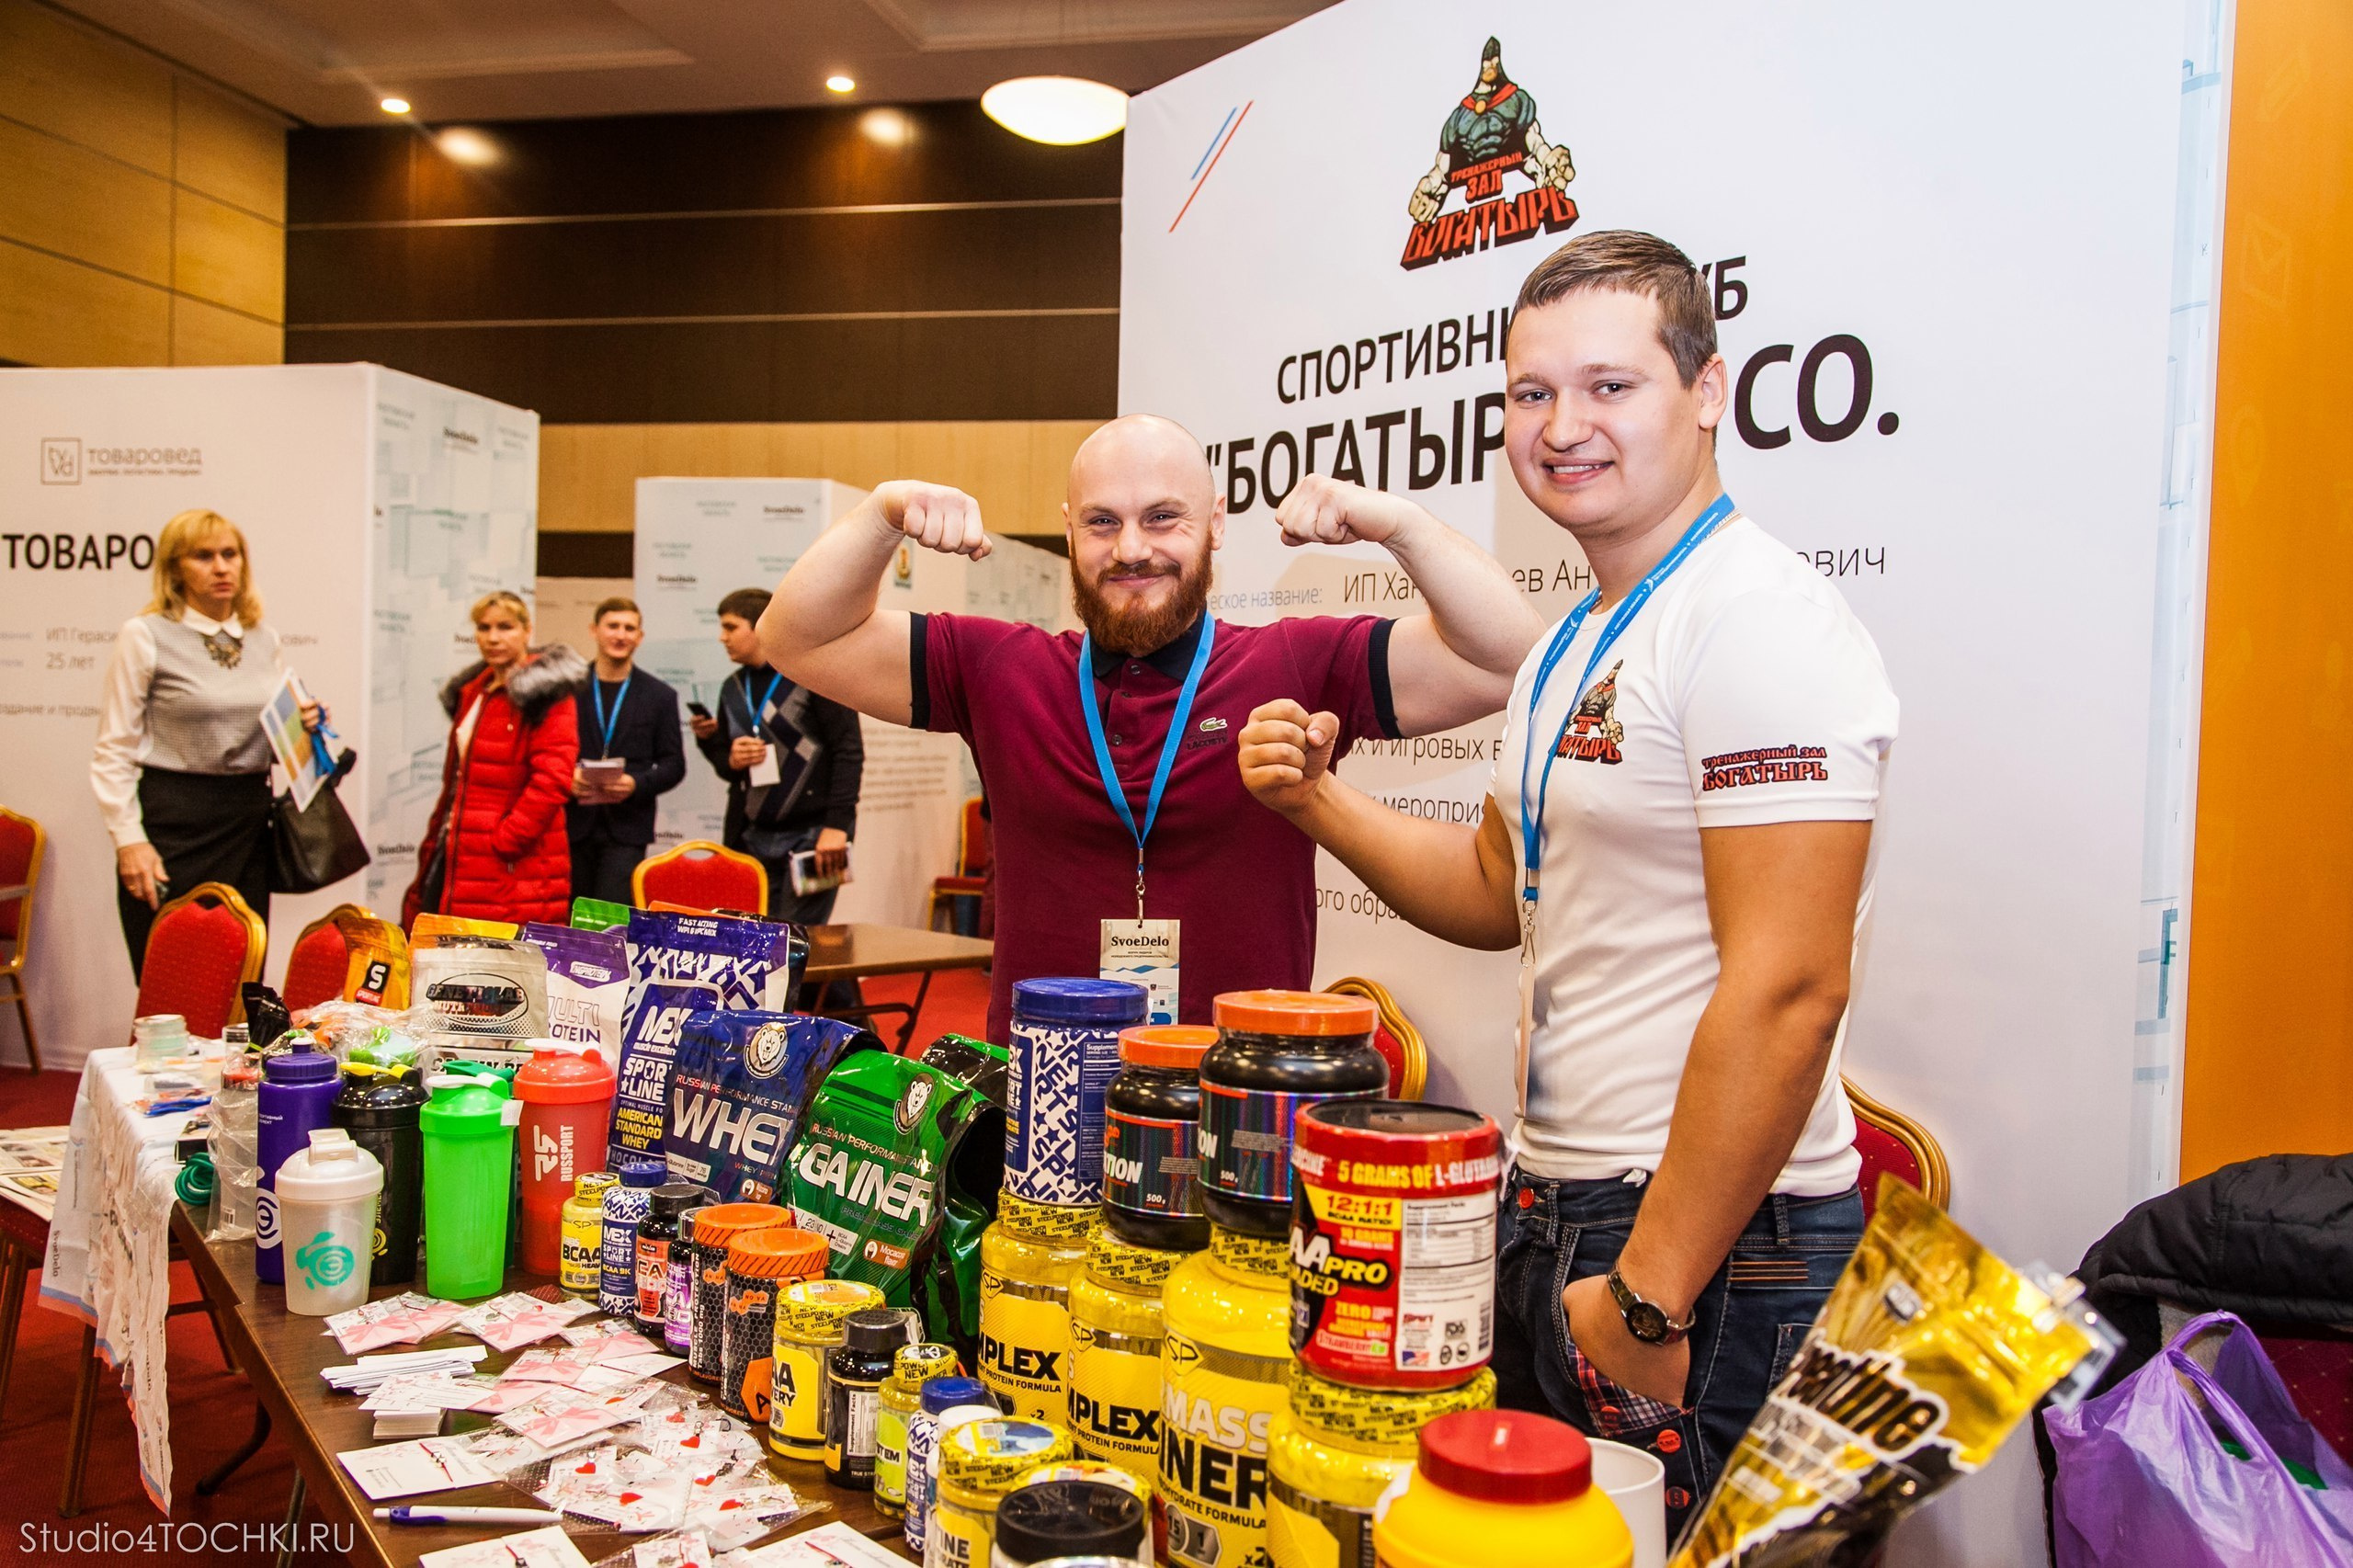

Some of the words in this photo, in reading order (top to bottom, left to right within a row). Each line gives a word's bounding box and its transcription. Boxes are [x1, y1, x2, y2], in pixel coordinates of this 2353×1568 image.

[1467, 169, 1503, 200] ЗАЛ
[1401, 186, 1578, 270] БОГАТЫРЬ
[1207, 591, 1247, 611] еское
[1251, 586, 1324, 608] название:
[1344, 573, 1376, 603] ИП
[46, 652, 73, 670] 25
[1702, 761, 1829, 791] БОГАТЫРЬ
[1351, 890, 1403, 925] обра
[1110, 936, 1170, 948] SvoeDelo
[637, 1006, 693, 1047] MEX
[623, 1057, 673, 1083] SPOR
[676, 1074, 710, 1091] RUSSIAN
[628, 1078, 665, 1102] LINE
[615, 1119, 663, 1141] STANDARD
[617, 1107, 663, 1128] AMERICAN
[560, 1124, 574, 1182] RUSSPORT
[621, 1133, 650, 1150] WHEY
[847, 1133, 896, 1161] PERFORMA
[798, 1142, 935, 1228] GAINER
[1337, 1159, 1350, 1184] 5
[1351, 1162, 1411, 1188] GRAMS
[1411, 1164, 1434, 1188] OF
[1327, 1195, 1393, 1216] 12:1:1
[603, 1225, 631, 1244] MEX
[603, 1244, 631, 1257] SPORT
[983, 1270, 1002, 1292] SP
[1324, 1256, 1389, 1285] PRO
[1072, 1322, 1094, 1345] SP
[1166, 1335, 1199, 1367] SP
[904, 1366, 929, 1380] NEW
[986, 1369, 1014, 1386] PROTEIN
[1016, 1380, 1062, 1393] FORMULA
[1163, 1381, 1272, 1454] MASS
[1077, 1431, 1109, 1449] PROTEIN
[1205, 1503, 1267, 1530] FORMULA
